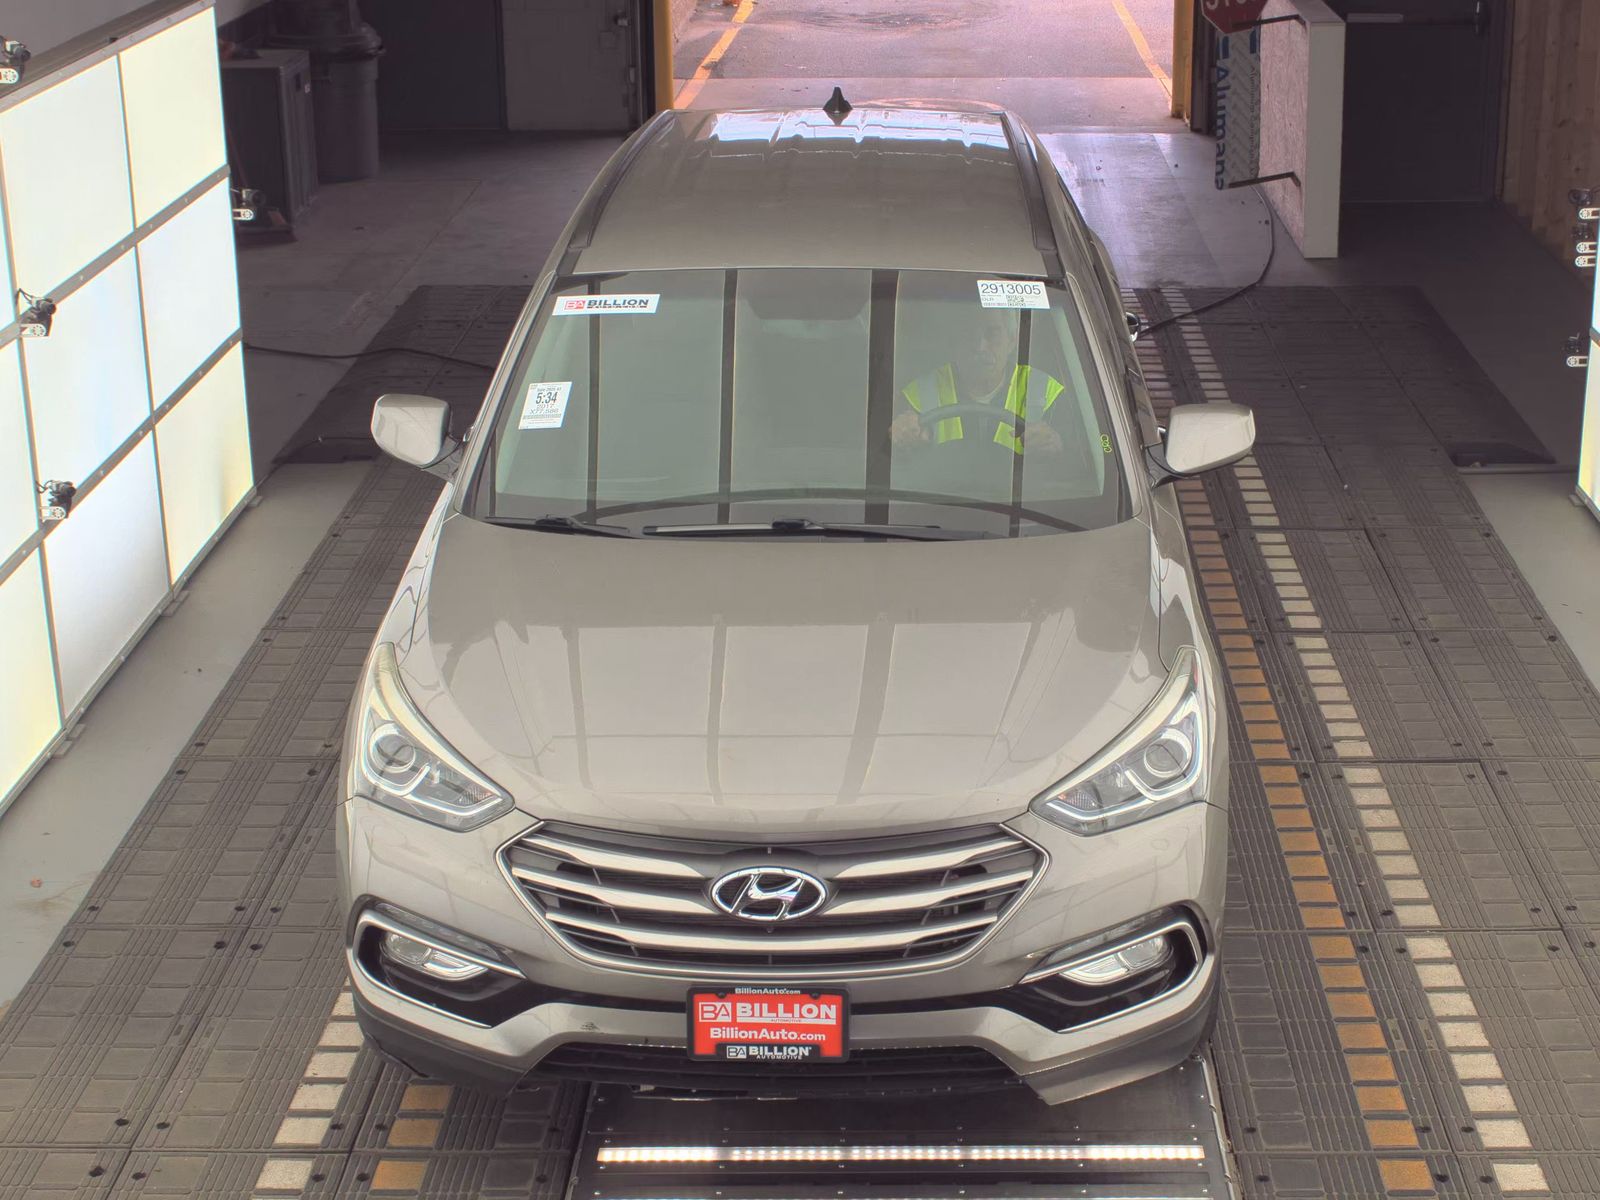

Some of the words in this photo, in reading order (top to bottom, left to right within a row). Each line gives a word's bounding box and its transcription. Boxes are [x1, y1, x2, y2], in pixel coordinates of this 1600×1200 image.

[981, 284, 1041, 295] 2913005
[587, 299, 650, 307] BILLION
[536, 391, 559, 404] 5:34
[736, 1002, 837, 1019] BILLION
[709, 1027, 826, 1041] BillionAuto.com
[748, 1046, 809, 1056] BILLION
